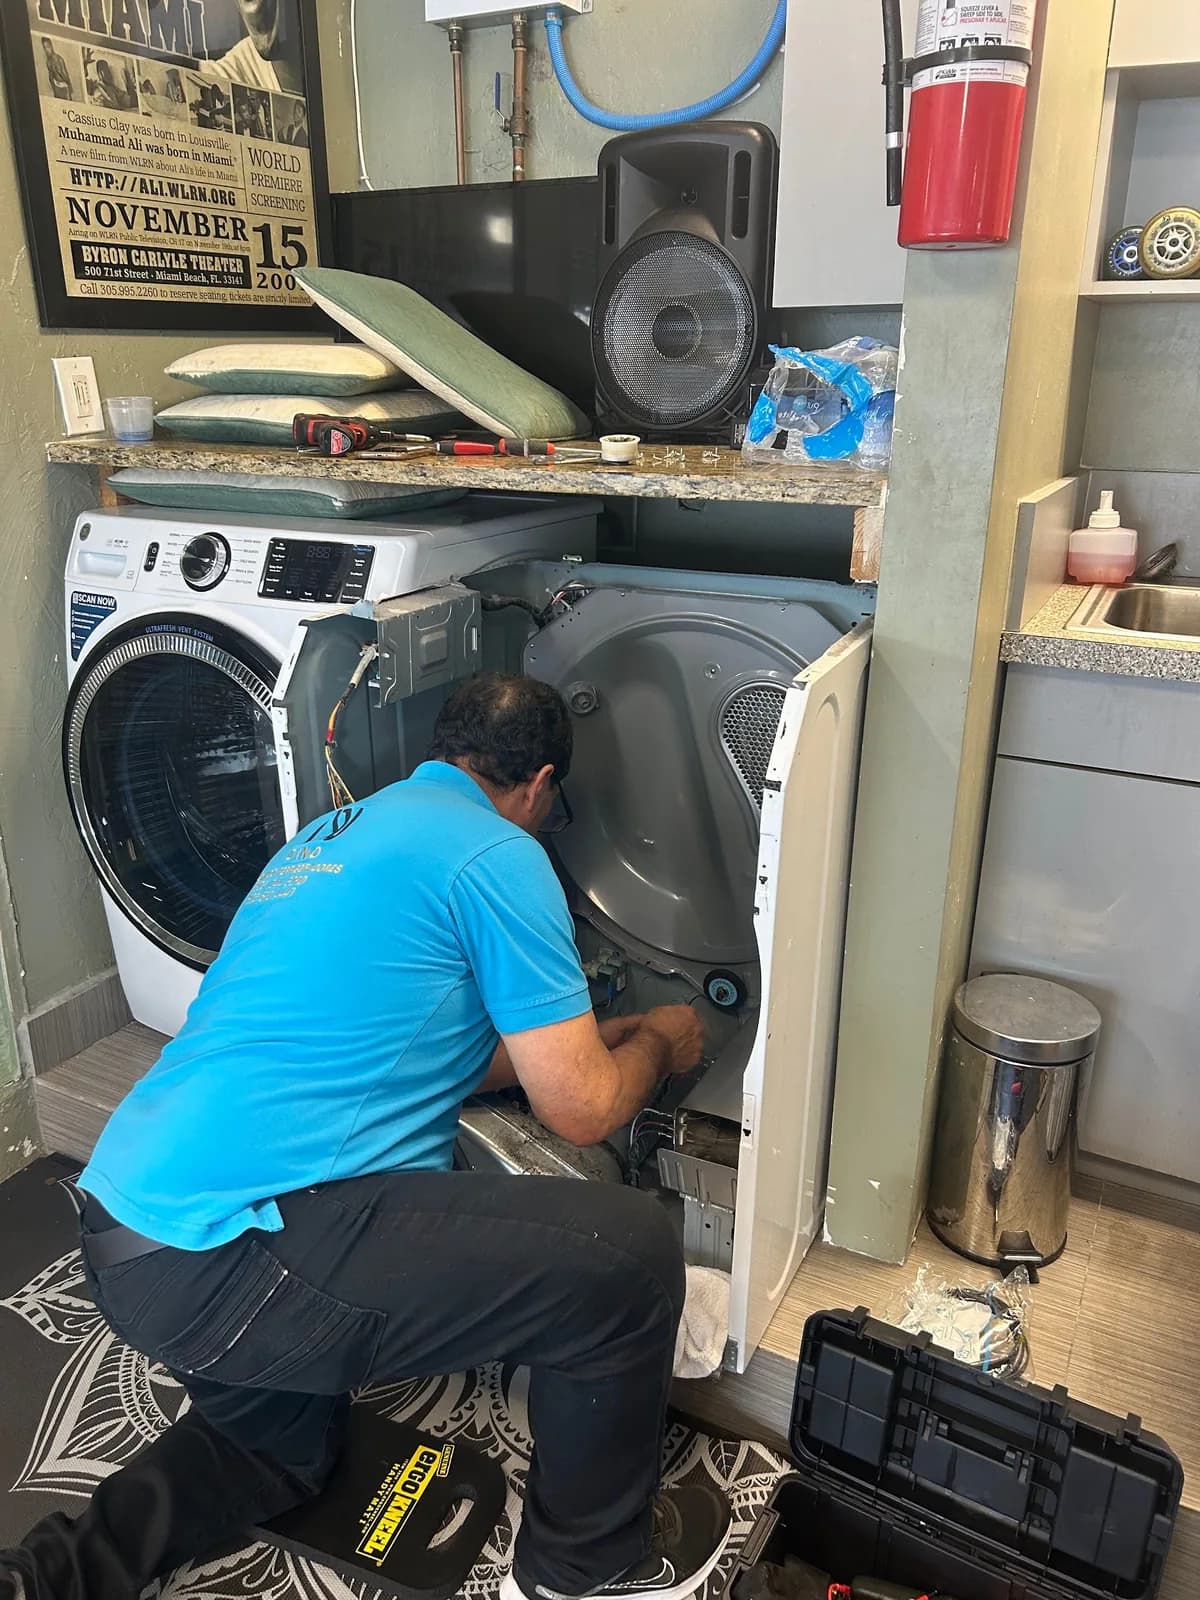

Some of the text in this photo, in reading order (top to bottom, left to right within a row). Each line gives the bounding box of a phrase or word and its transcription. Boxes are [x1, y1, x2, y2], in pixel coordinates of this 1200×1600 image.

[109, 117, 130, 135] Clay
[132, 124, 152, 136] was
[153, 124, 175, 142] born
[178, 130, 187, 143] in
[57, 126, 125, 148] Muhammad
[128, 138, 143, 151] Ali
[145, 144, 165, 155] was
[166, 144, 190, 159] born
[192, 149, 200, 162] in
[61, 145, 68, 156] A
[70, 148, 88, 158] new
[90, 148, 107, 161] film
[108, 152, 128, 165] from
[129, 156, 154, 168] WLRN
[156, 160, 178, 173] about
[196, 166, 206, 176] life
[208, 170, 214, 178] in
[248, 147, 301, 174] WORLD
[70, 168, 236, 206] HTTP://ALI.WLRN.ORG
[250, 172, 303, 193] PREMIERE
[250, 192, 306, 212] SCREENING
[65, 196, 249, 242] NOVEMBER
[68, 228, 88, 239] Airing
[89, 230, 98, 238] on
[98, 230, 118, 240] WLRN
[119, 233, 138, 242] Public
[194, 240, 220, 249] Nvember
[252, 222, 308, 271] 15
[82, 245, 244, 273] BYRON CARLYLE THEATER
[84, 266, 102, 276] 500
[104, 268, 122, 278] 71st
[124, 268, 150, 280] Street
[156, 270, 182, 281] Miami
[184, 272, 210, 285] Beach,
[223, 275, 244, 285] 33141
[256, 272, 304, 291] 200
[80, 282, 98, 295] Call
[100, 284, 158, 298] 305.995.2260
[160, 289, 168, 298] to
[170, 290, 198, 300] reserve
[228, 290, 252, 302] tickets
[253, 294, 264, 302] are
[266, 293, 286, 304] strictly
[78, 594, 96, 604] SCAN
[97, 596, 116, 607] NOW
[145, 624, 214, 641] ULTRAFRESH VENT SYSTEM
[439, 1446, 451, 1475] GENUINE
[377, 1462, 400, 1496] HANDY
[362, 1497, 380, 1519] MAT
[362, 1494, 413, 1554] KNEEL
